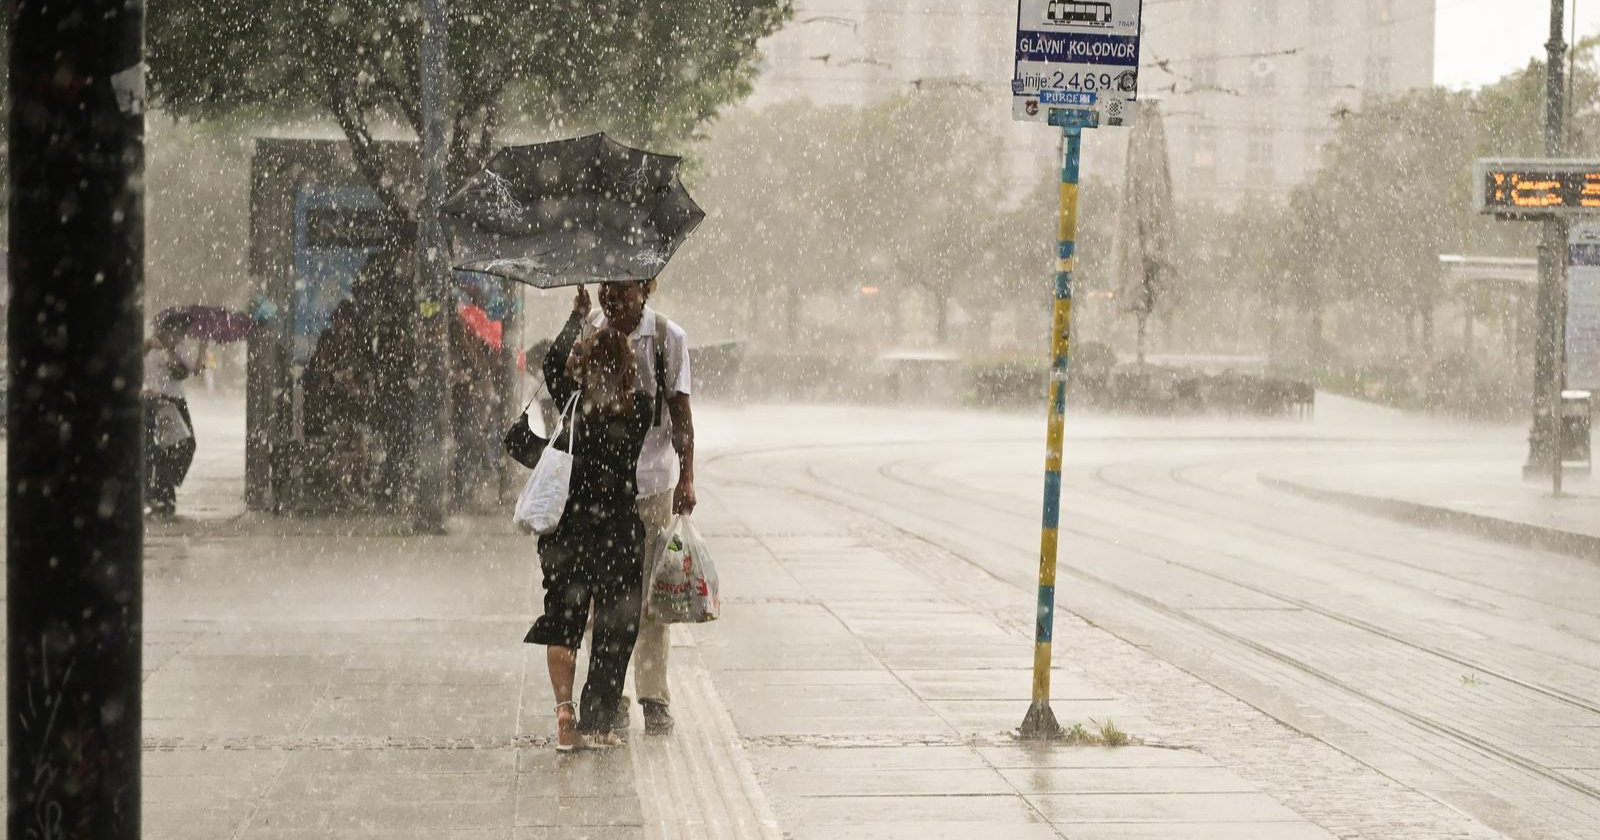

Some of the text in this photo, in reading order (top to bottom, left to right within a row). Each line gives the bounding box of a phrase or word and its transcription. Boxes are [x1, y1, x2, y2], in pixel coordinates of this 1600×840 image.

[1118, 20, 1135, 28] TRAM
[1020, 38, 1135, 58] GLAVNI KOLODVOR
